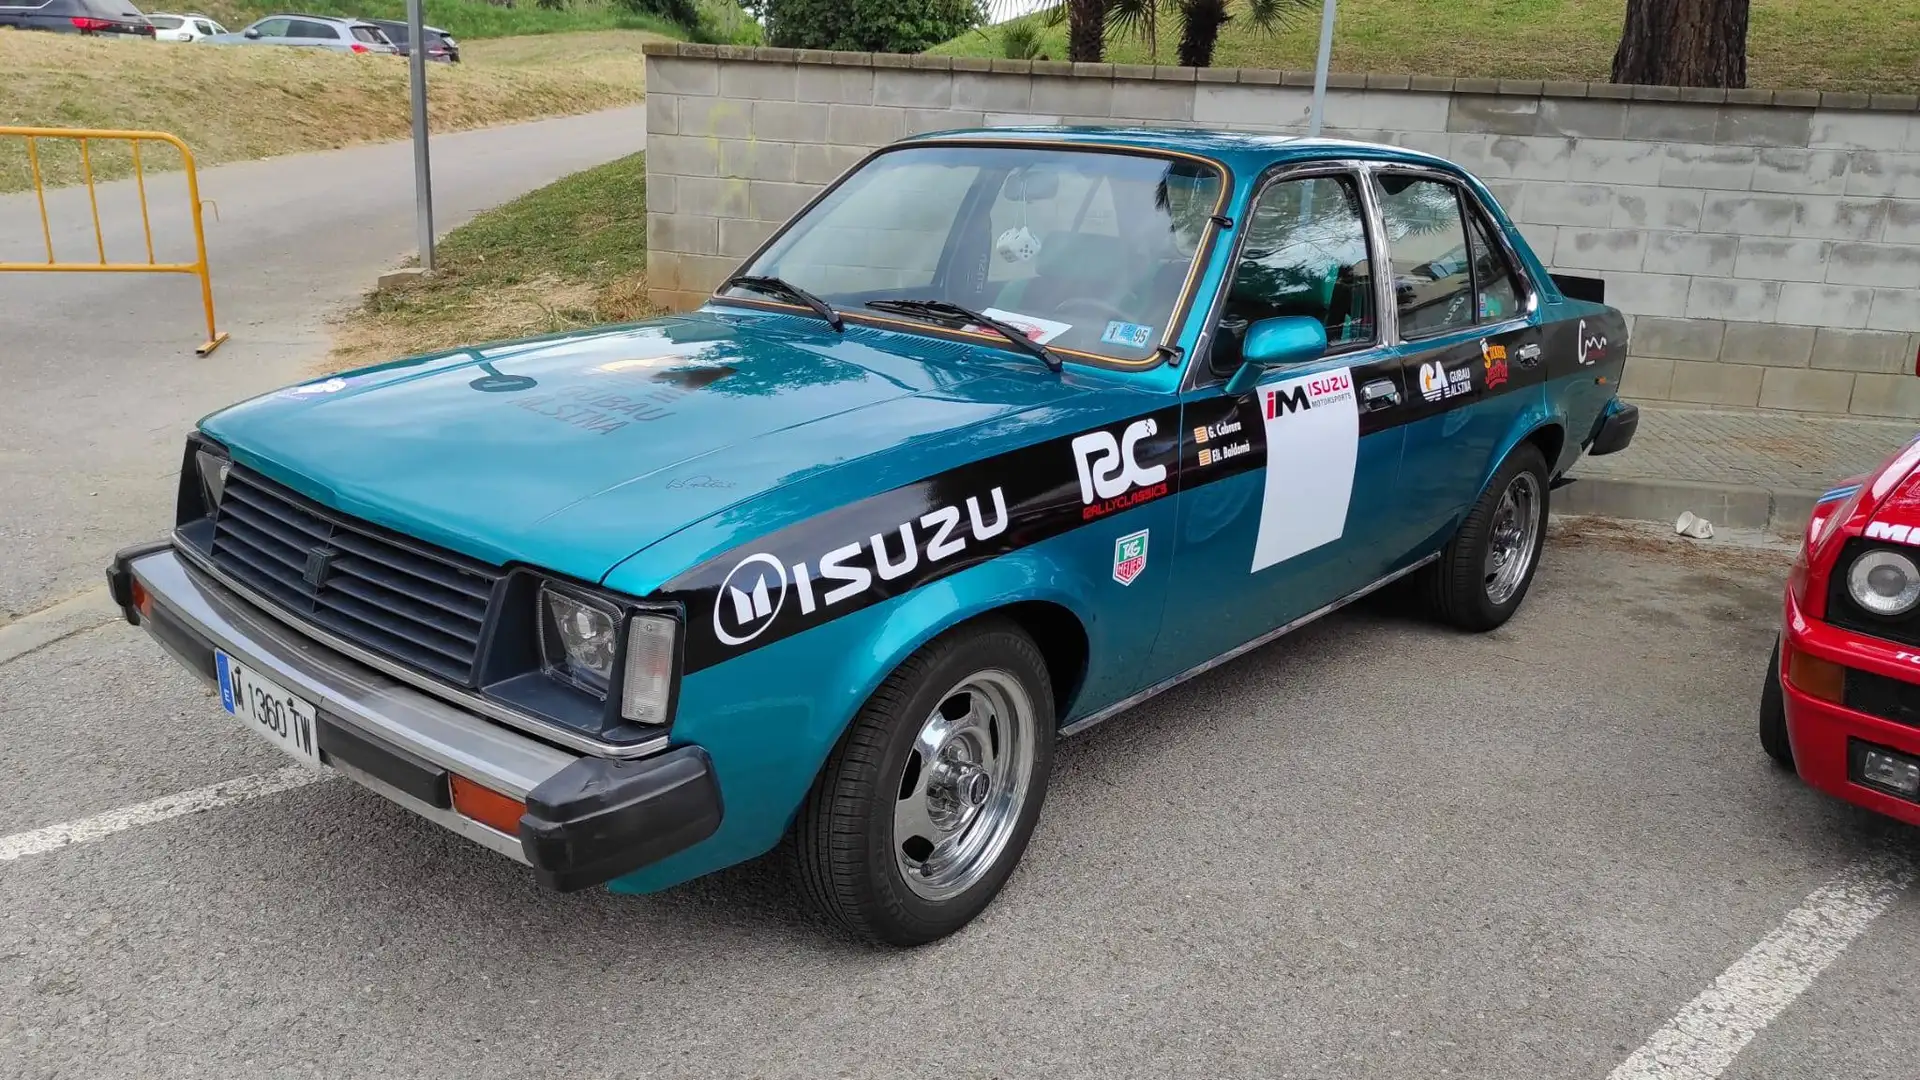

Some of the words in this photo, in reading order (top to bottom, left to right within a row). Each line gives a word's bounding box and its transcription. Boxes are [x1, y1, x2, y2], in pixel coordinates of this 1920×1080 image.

[1133, 328, 1148, 344] 95
[1307, 375, 1349, 396] ISUZU
[1311, 392, 1352, 408] MOTORSPORTS
[1207, 425, 1217, 439] G.
[1071, 418, 1167, 505] RC
[1082, 483, 1168, 521] RALLYCLASSICS
[792, 486, 1008, 616] ISUZU
[1122, 539, 1141, 561] TAG
[1116, 556, 1144, 579] HEUER
[248, 682, 287, 738] 1360
